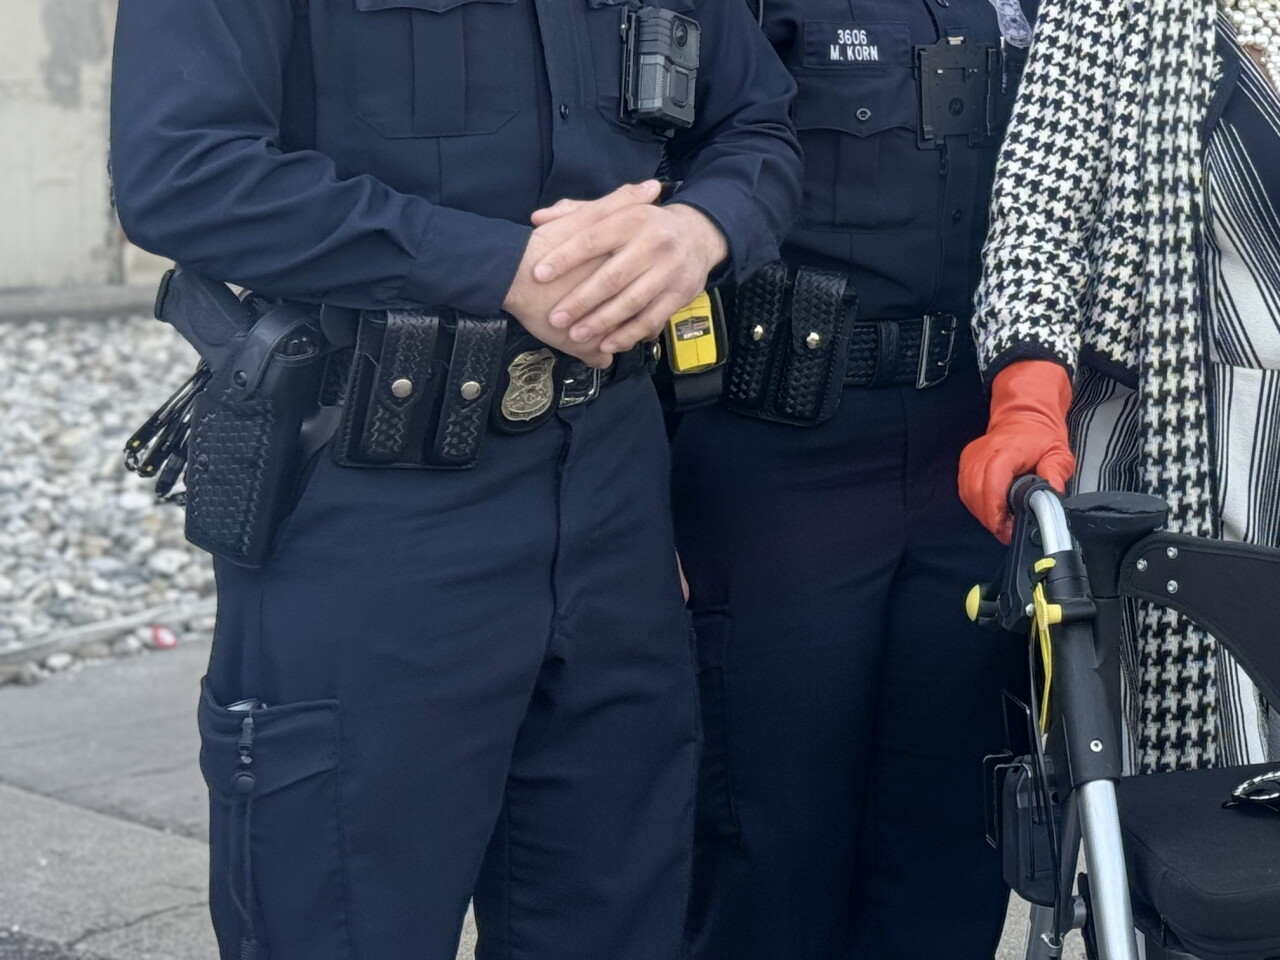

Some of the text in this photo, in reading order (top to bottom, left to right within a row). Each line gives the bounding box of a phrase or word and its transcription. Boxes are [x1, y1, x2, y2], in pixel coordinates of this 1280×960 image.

[837, 29, 868, 44] 3606
[830, 44, 879, 61] M. KORN
